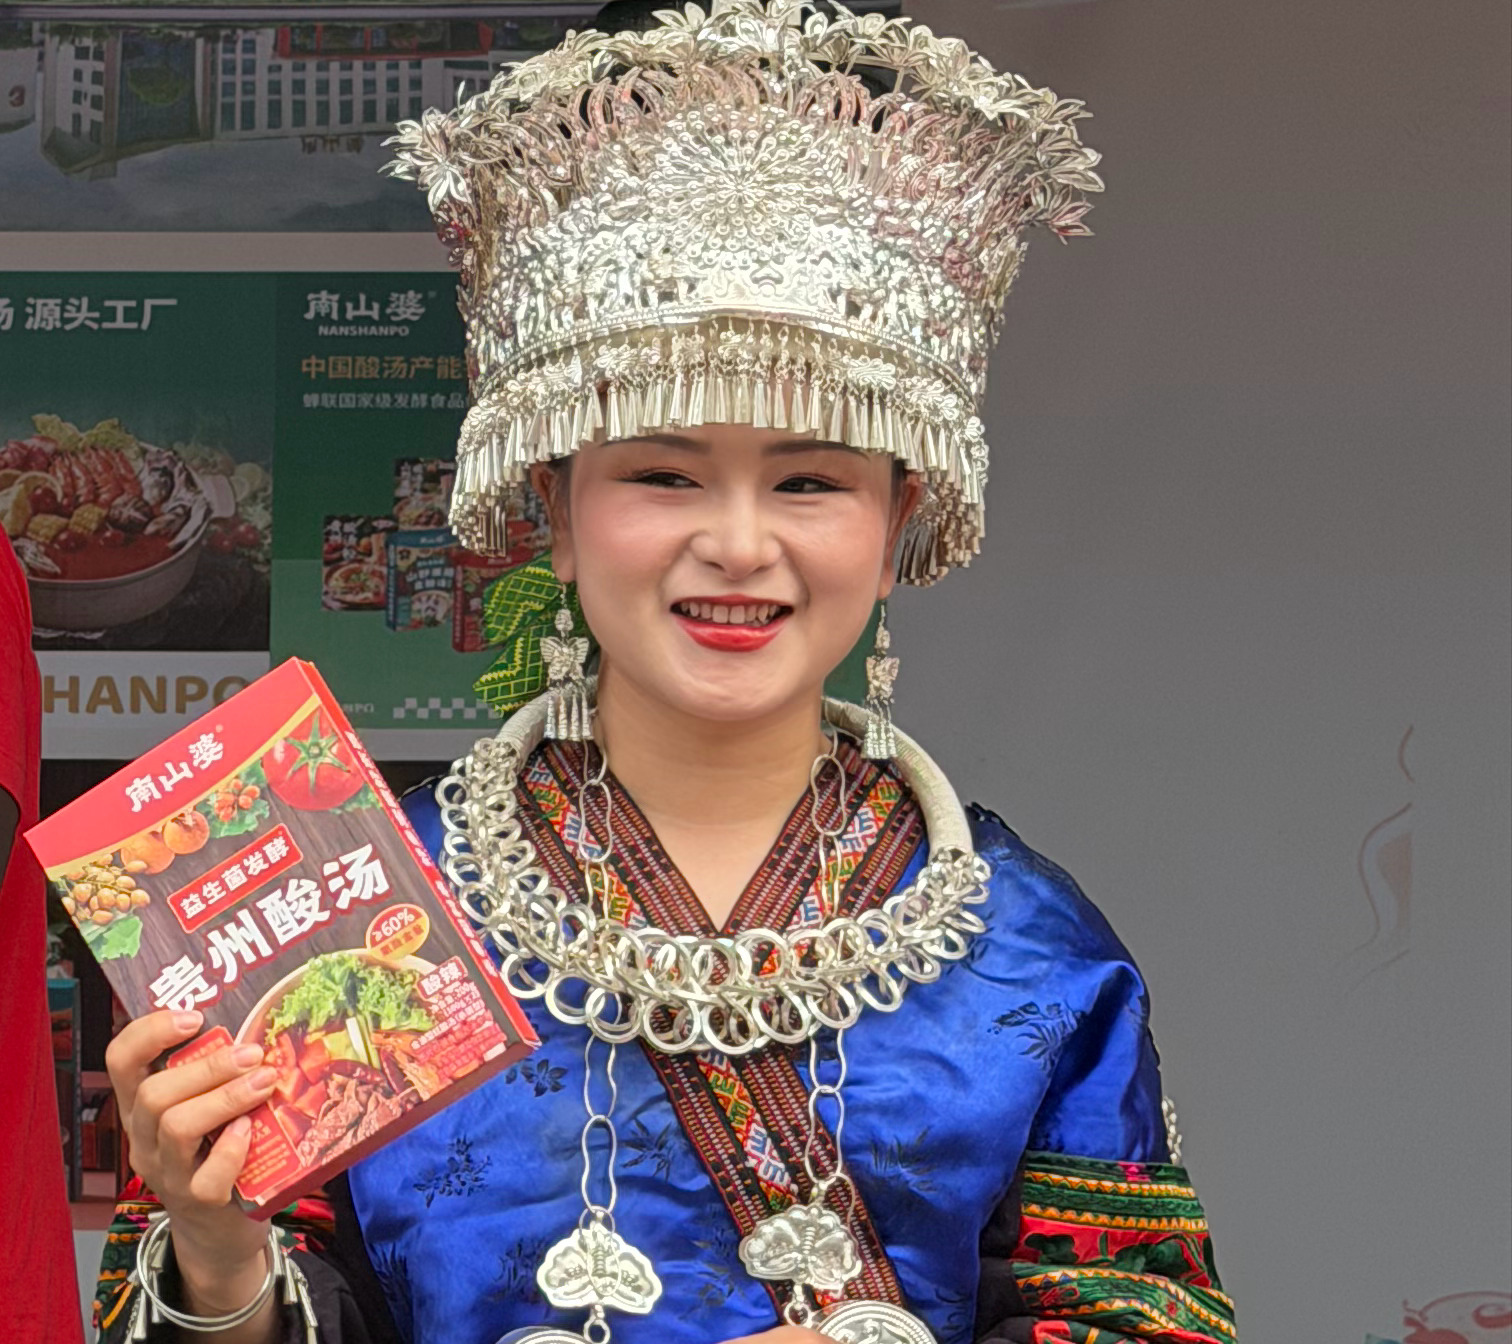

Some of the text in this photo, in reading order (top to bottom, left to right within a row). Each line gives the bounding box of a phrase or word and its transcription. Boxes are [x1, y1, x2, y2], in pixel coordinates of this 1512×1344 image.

[25, 297, 179, 333] 源头工厂
[303, 290, 426, 321] 南山婆
[318, 325, 410, 337] NANSHANPO
[301, 355, 468, 381] 中国酸汤产能
[125, 732, 224, 813] 南山婆
[179, 835, 291, 920] 益生菌发酵
[149, 843, 390, 1012] 贵州酸汤
